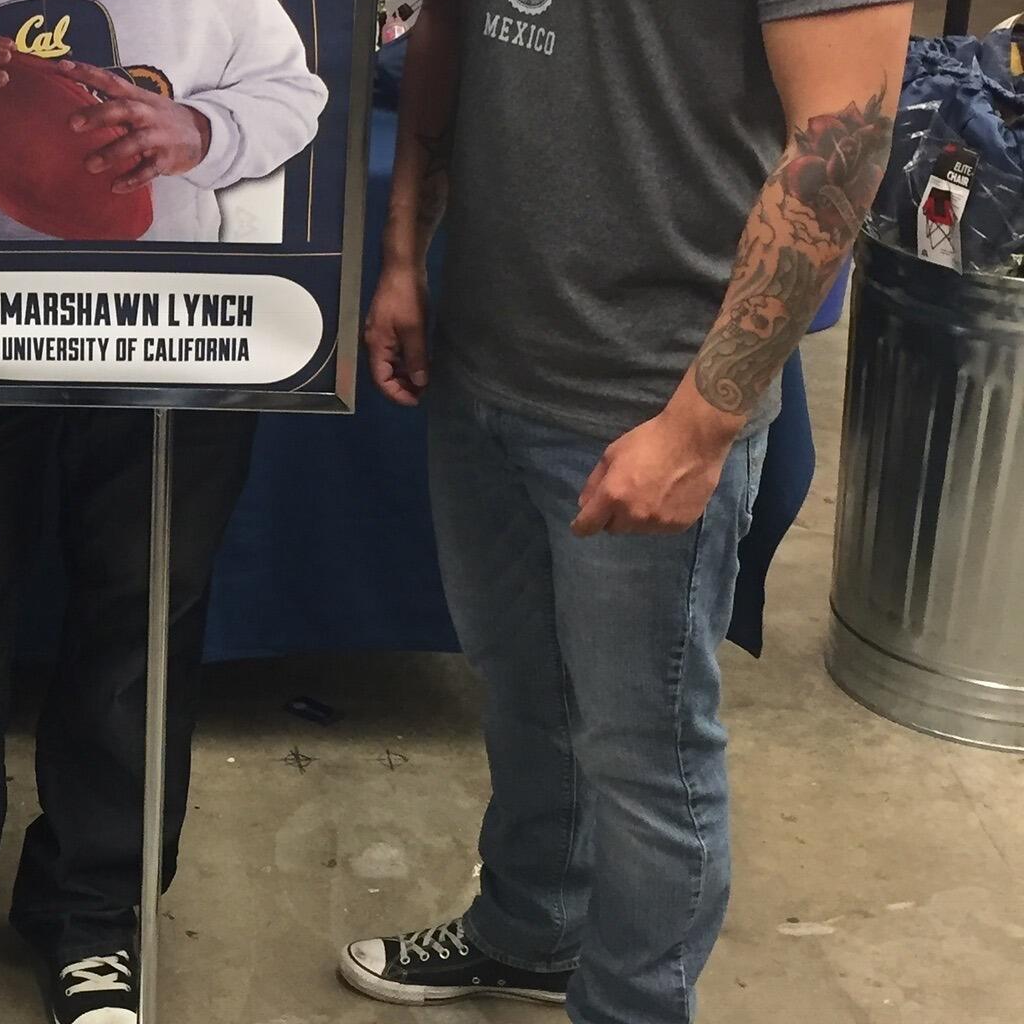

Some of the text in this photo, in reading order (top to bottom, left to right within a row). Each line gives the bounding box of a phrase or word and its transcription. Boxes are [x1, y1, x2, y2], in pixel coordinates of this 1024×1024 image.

[14, 14, 72, 59] Cal
[483, 12, 556, 56] MEXICO
[946, 170, 970, 187] CHAIR
[953, 161, 974, 176] ELITE
[0, 291, 254, 327] MARSHAWN LYNCH
[1, 336, 251, 362] UNIVERSITY OF CALIFORNIA
